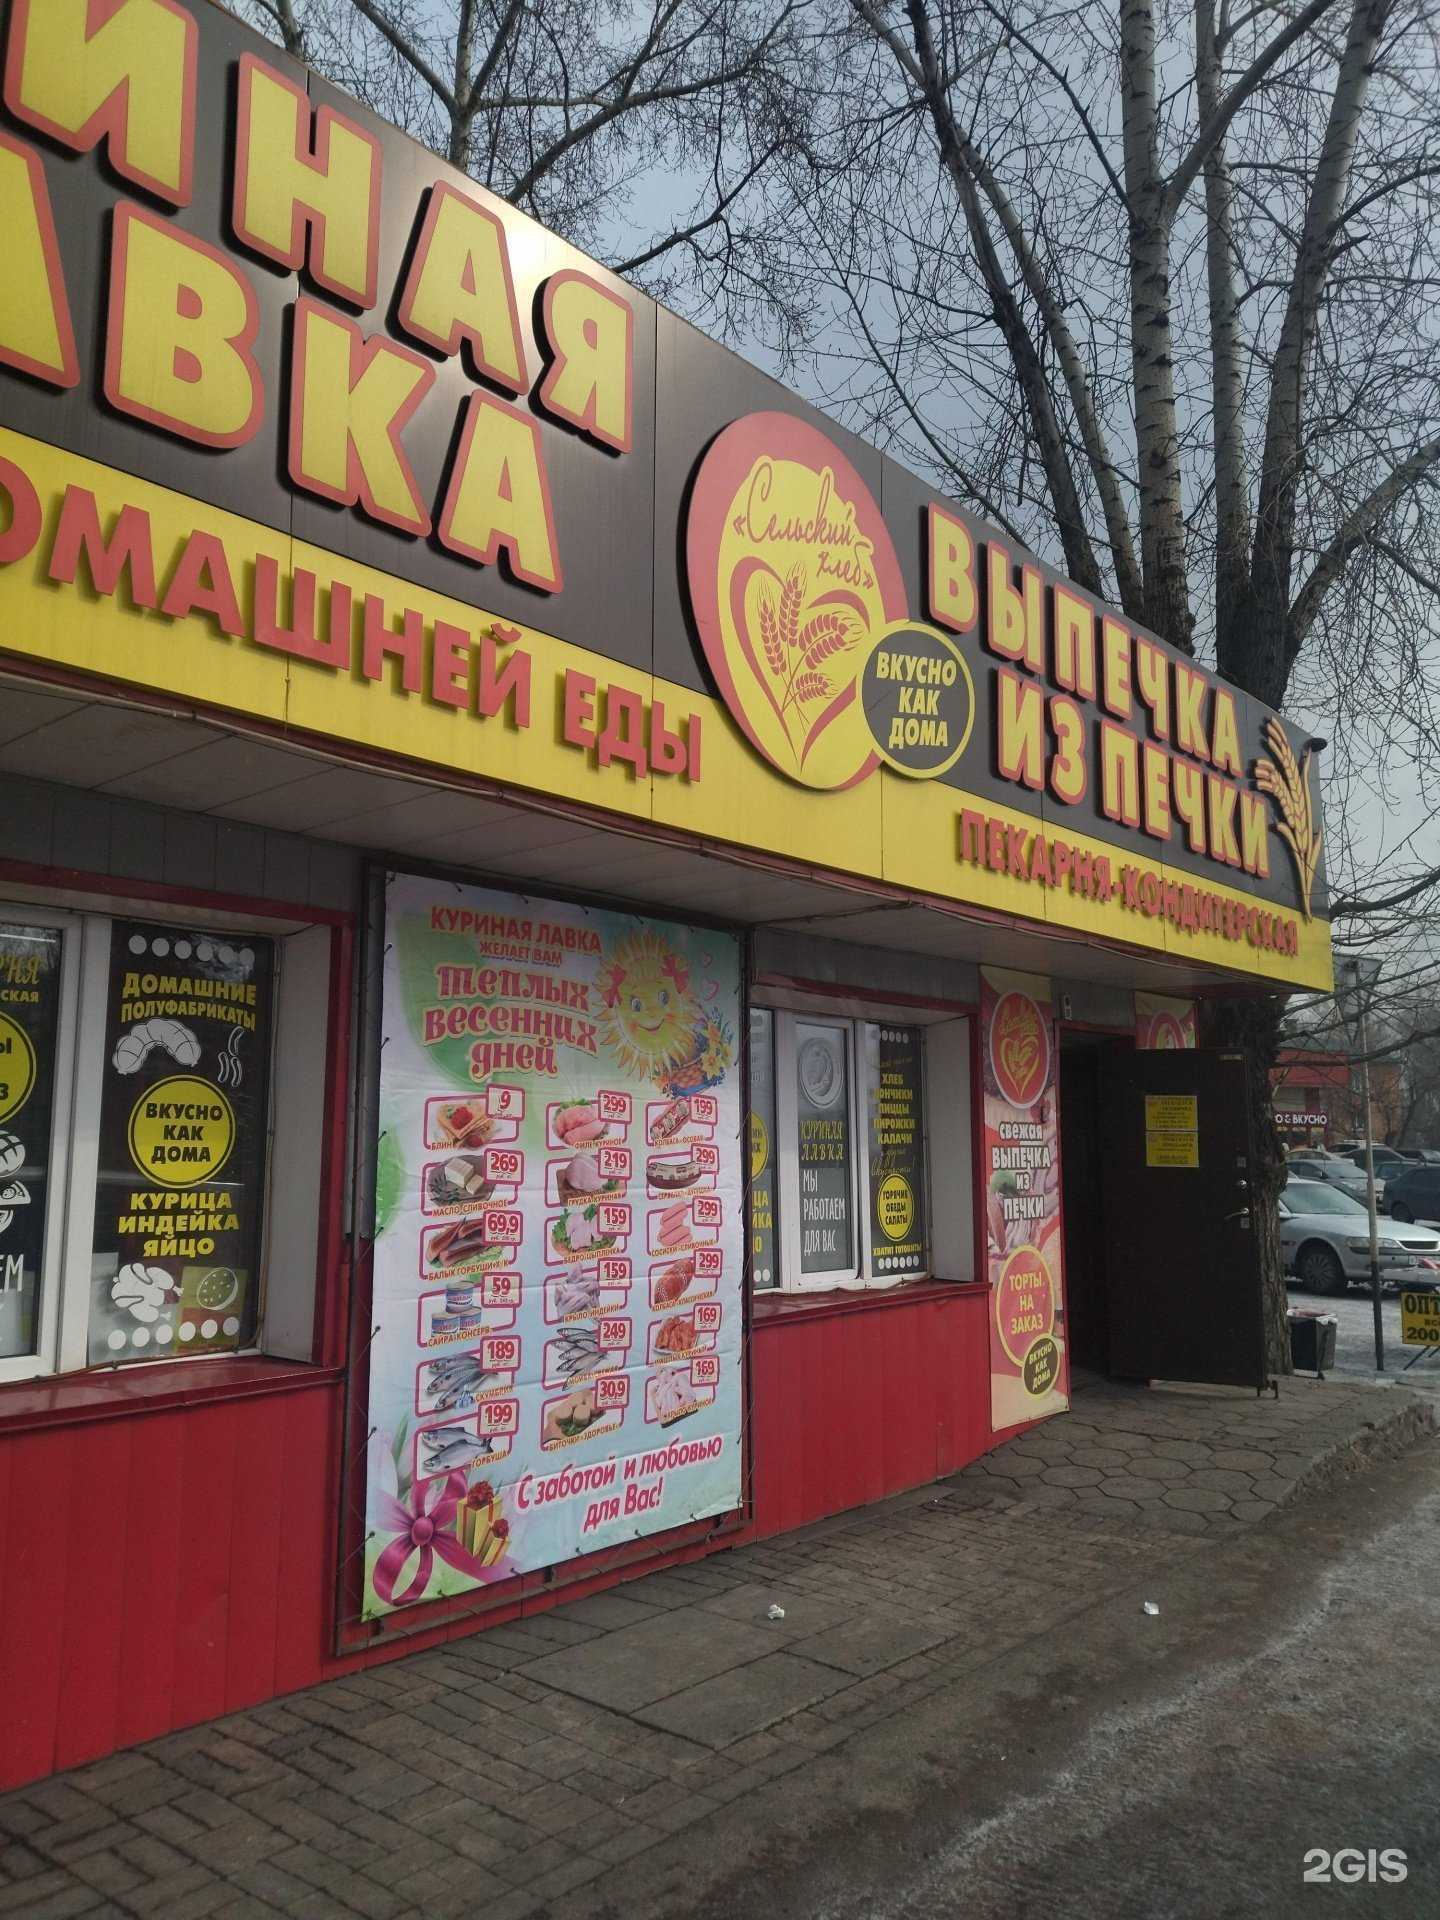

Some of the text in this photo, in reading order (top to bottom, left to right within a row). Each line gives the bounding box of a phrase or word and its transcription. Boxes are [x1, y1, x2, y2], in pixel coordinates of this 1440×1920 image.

[929, 501, 1243, 778] ВЫПЕЧКА
[877, 651, 957, 687] ВКУСНО
[899, 686, 941, 716] КАК
[564, 668, 700, 782] ЕДЫ
[889, 717, 948, 749] ДОМА
[999, 667, 1271, 879] ИЗ ПЕЧКИ
[960, 808, 1298, 957] ПЕКАРНЯ-КОНДИТЕРСКАЯ
[431, 906, 602, 953] КУРИНАЯ ЛАВКА
[480, 941, 562, 964] ЖЕЛАЕТ ВАМ
[122, 972, 257, 1006] ДОМАШНИЕ
[121, 1000, 256, 1031] ПОЛУФАБРИКАТЫ
[882, 1074, 904, 1084] ХЛЕБ
[146, 1103, 223, 1121] ВКУСНО
[603, 1095, 627, 1112] 299
[694, 1099, 713, 1115] 199
[873, 1119, 916, 1129] ПИРОЖКИ
[1292, 1114, 1327, 1124] ВКУСНО
[164, 1125, 204, 1141] КАК
[800, 1120, 843, 1140] КУРИНАЯ
[877, 1133, 913, 1144] КАЛАЧИ
[151, 1146, 211, 1164] ДОМА
[604, 1151, 627, 1168] 219
[695, 1148, 715, 1164] 299
[800, 1144, 844, 1160] ЛАВКА
[992, 1147, 1051, 1169] ВЫПЕЧКА
[491, 1153, 518, 1173] 269
[803, 1169, 818, 1192] МЫ
[130, 1193, 232, 1211] КУРИЦА
[432, 1199, 508, 1217] МАСЛО СЛИВОЧНОЕ
[697, 1200, 718, 1216] 299
[803, 1198, 846, 1221] РАБОТАЕМ
[885, 1203, 906, 1213] ОБЕДЫ
[1004, 1197, 1044, 1219] ПЕЧКИ
[118, 1210, 240, 1235] ИНДЕЙКА
[487, 1214, 519, 1235] 69,9
[604, 1208, 627, 1225] 159
[885, 1215, 908, 1225] САЛАТЫ
[143, 1235, 215, 1258] ЯЙЦО
[804, 1229, 836, 1256] ДЛЯ ВАС
[699, 1253, 719, 1269] 299
[428, 1268, 456, 1281] БАЛЫК
[604, 1262, 627, 1280] 159
[492, 1277, 511, 1296] 59
[1009, 1272, 1043, 1292] ТОРТЫ
[1019, 1295, 1034, 1312] НА
[697, 1307, 717, 1323] 169
[1011, 1314, 1044, 1335] ЗАКАЗ
[603, 1322, 627, 1340] 249
[487, 1341, 514, 1360] 189
[1029, 1343, 1053, 1364] ВКУСНО
[695, 1361, 715, 1376] 169
[1035, 1357, 1048, 1373] КАК
[600, 1381, 626, 1399] 30,9
[1033, 1369, 1051, 1392] ДОМА
[486, 1405, 513, 1424] 199
[471, 1451, 508, 1469] ГОРБУША
[518, 1436, 723, 1508] С заботой и любовью
[583, 1478, 663, 1532] для Вас!
